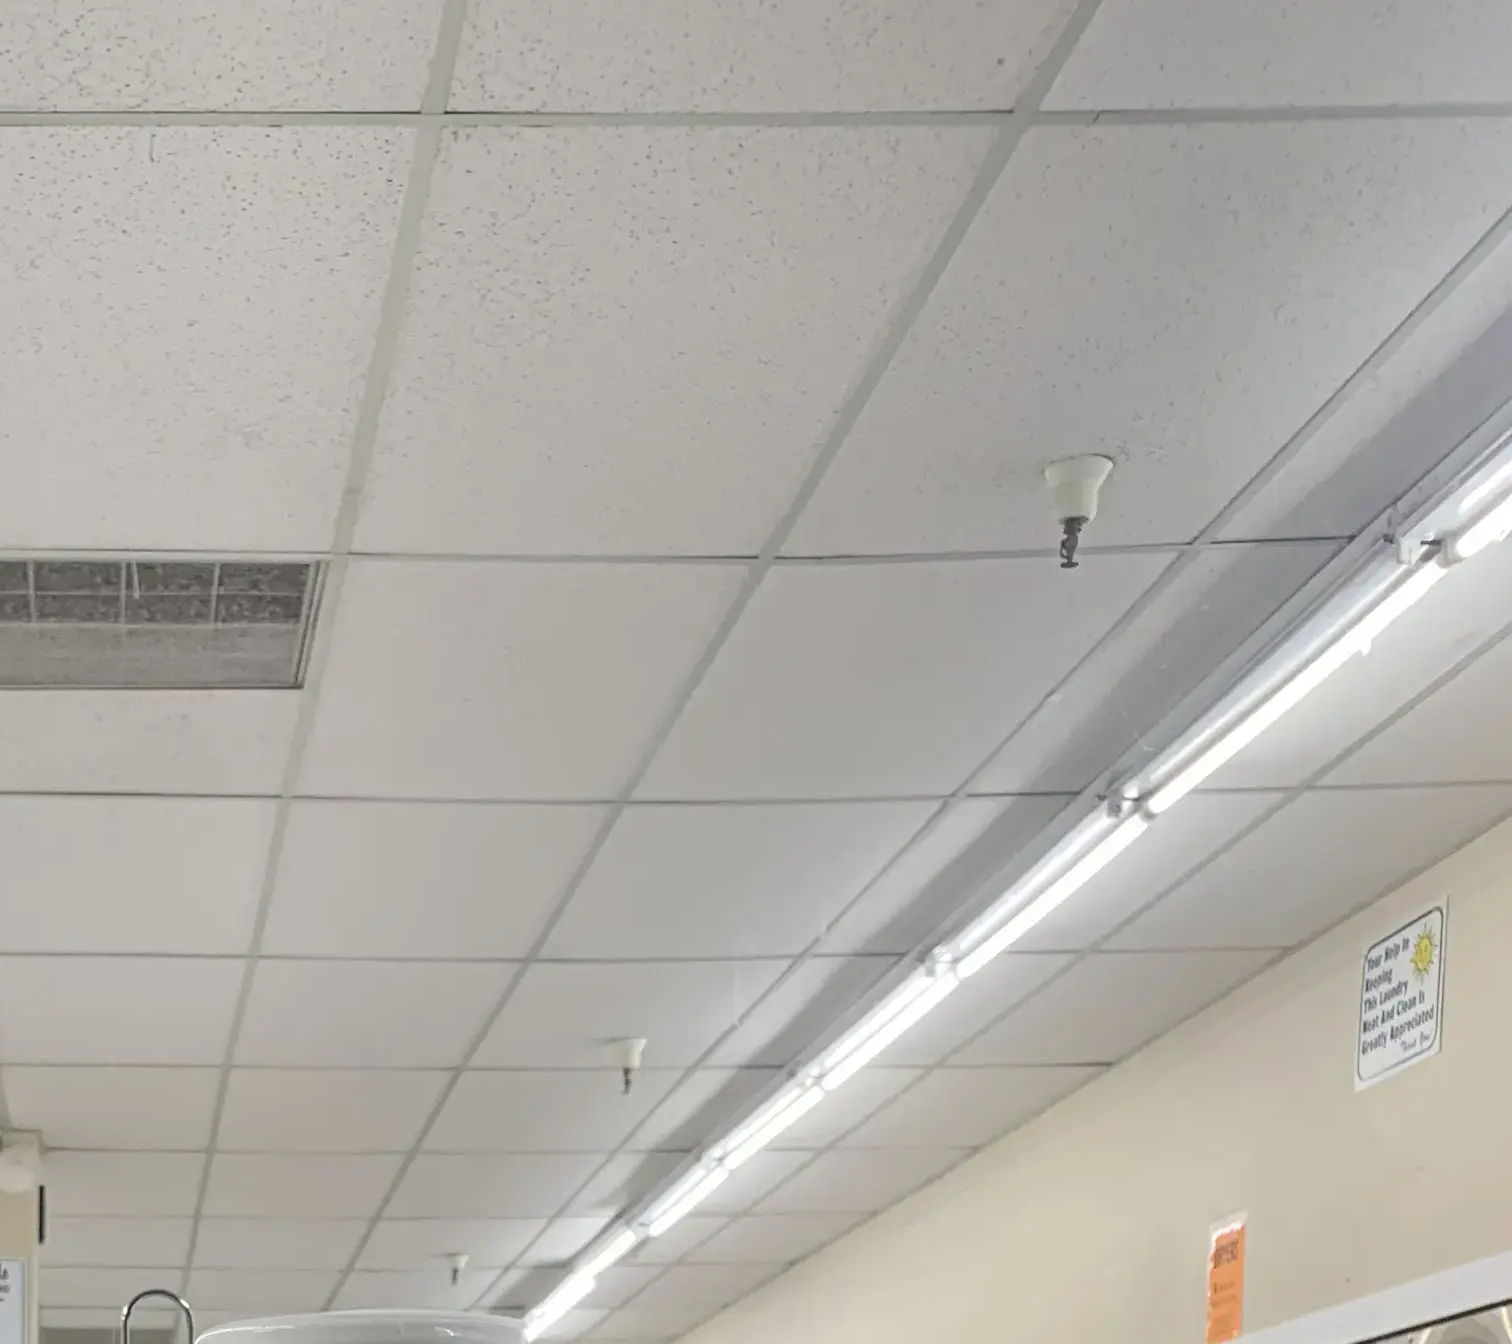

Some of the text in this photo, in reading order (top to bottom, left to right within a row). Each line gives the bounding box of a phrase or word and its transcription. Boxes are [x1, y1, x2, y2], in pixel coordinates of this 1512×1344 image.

[1363, 1015, 1378, 1033] Neat
[1381, 1004, 1394, 1025] And
[1396, 996, 1417, 1017] Clean
[1364, 980, 1408, 1014] This Laundry
[1362, 1004, 1434, 1056] Greatly Appreciated
